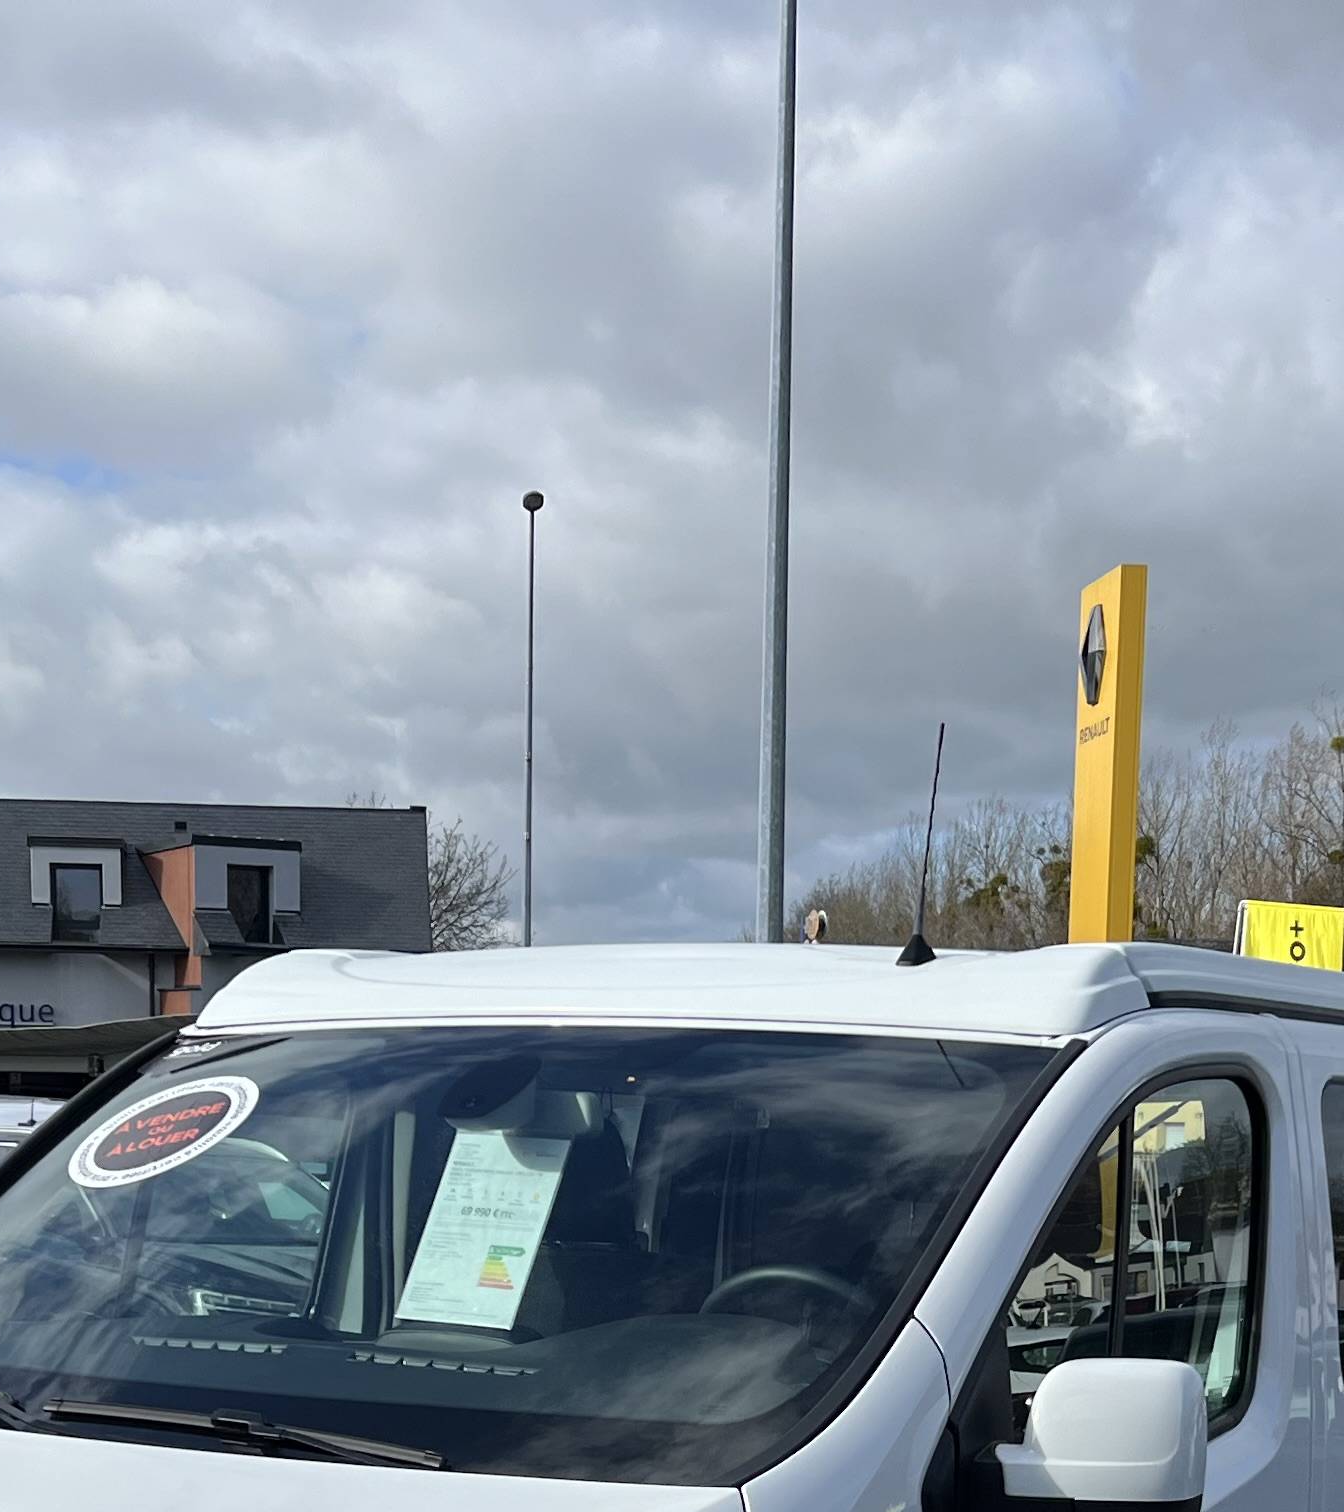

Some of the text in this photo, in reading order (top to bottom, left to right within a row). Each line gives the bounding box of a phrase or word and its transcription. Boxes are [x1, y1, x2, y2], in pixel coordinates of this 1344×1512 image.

[136, 1100, 228, 1131] VENDRE
[127, 1128, 200, 1154] LOUER
[148, 1123, 175, 1136] OU
